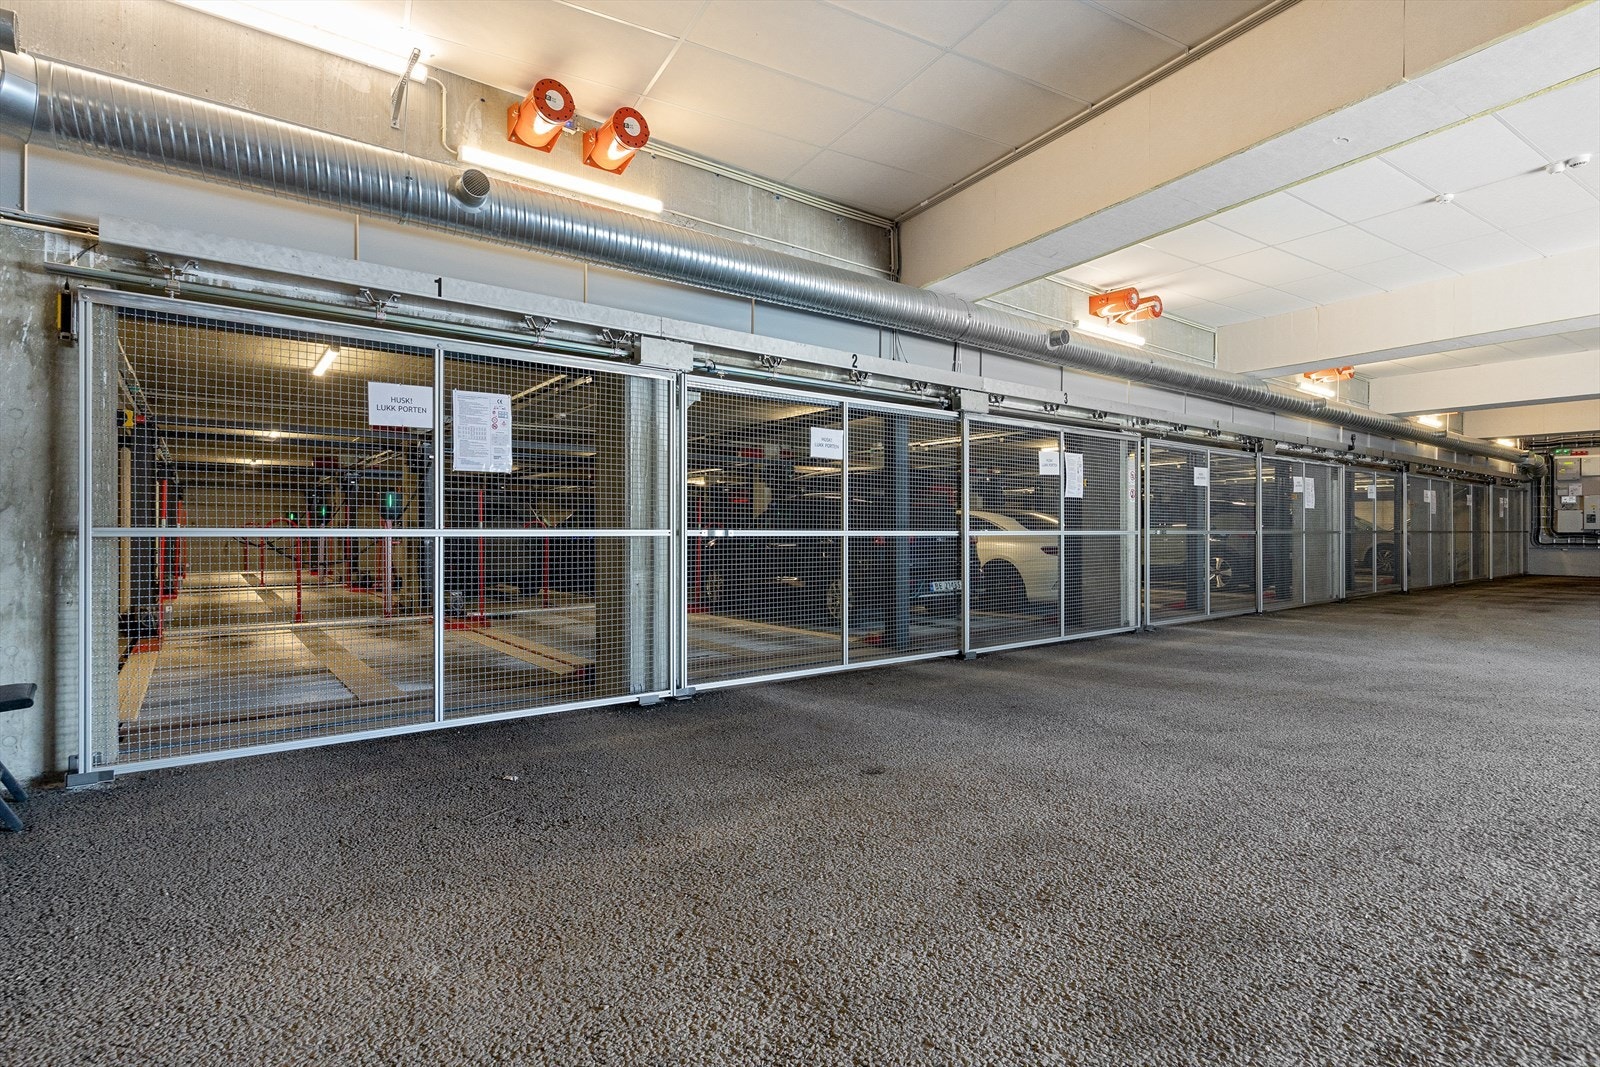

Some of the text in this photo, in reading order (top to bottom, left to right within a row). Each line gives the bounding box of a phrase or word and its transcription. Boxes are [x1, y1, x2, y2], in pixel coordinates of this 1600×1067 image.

[434, 278, 442, 297] 1
[852, 353, 858, 369] 2
[390, 396, 413, 404] HUSK!
[1064, 392, 1068, 404] 3
[398, 405, 427, 414] PORTEN
